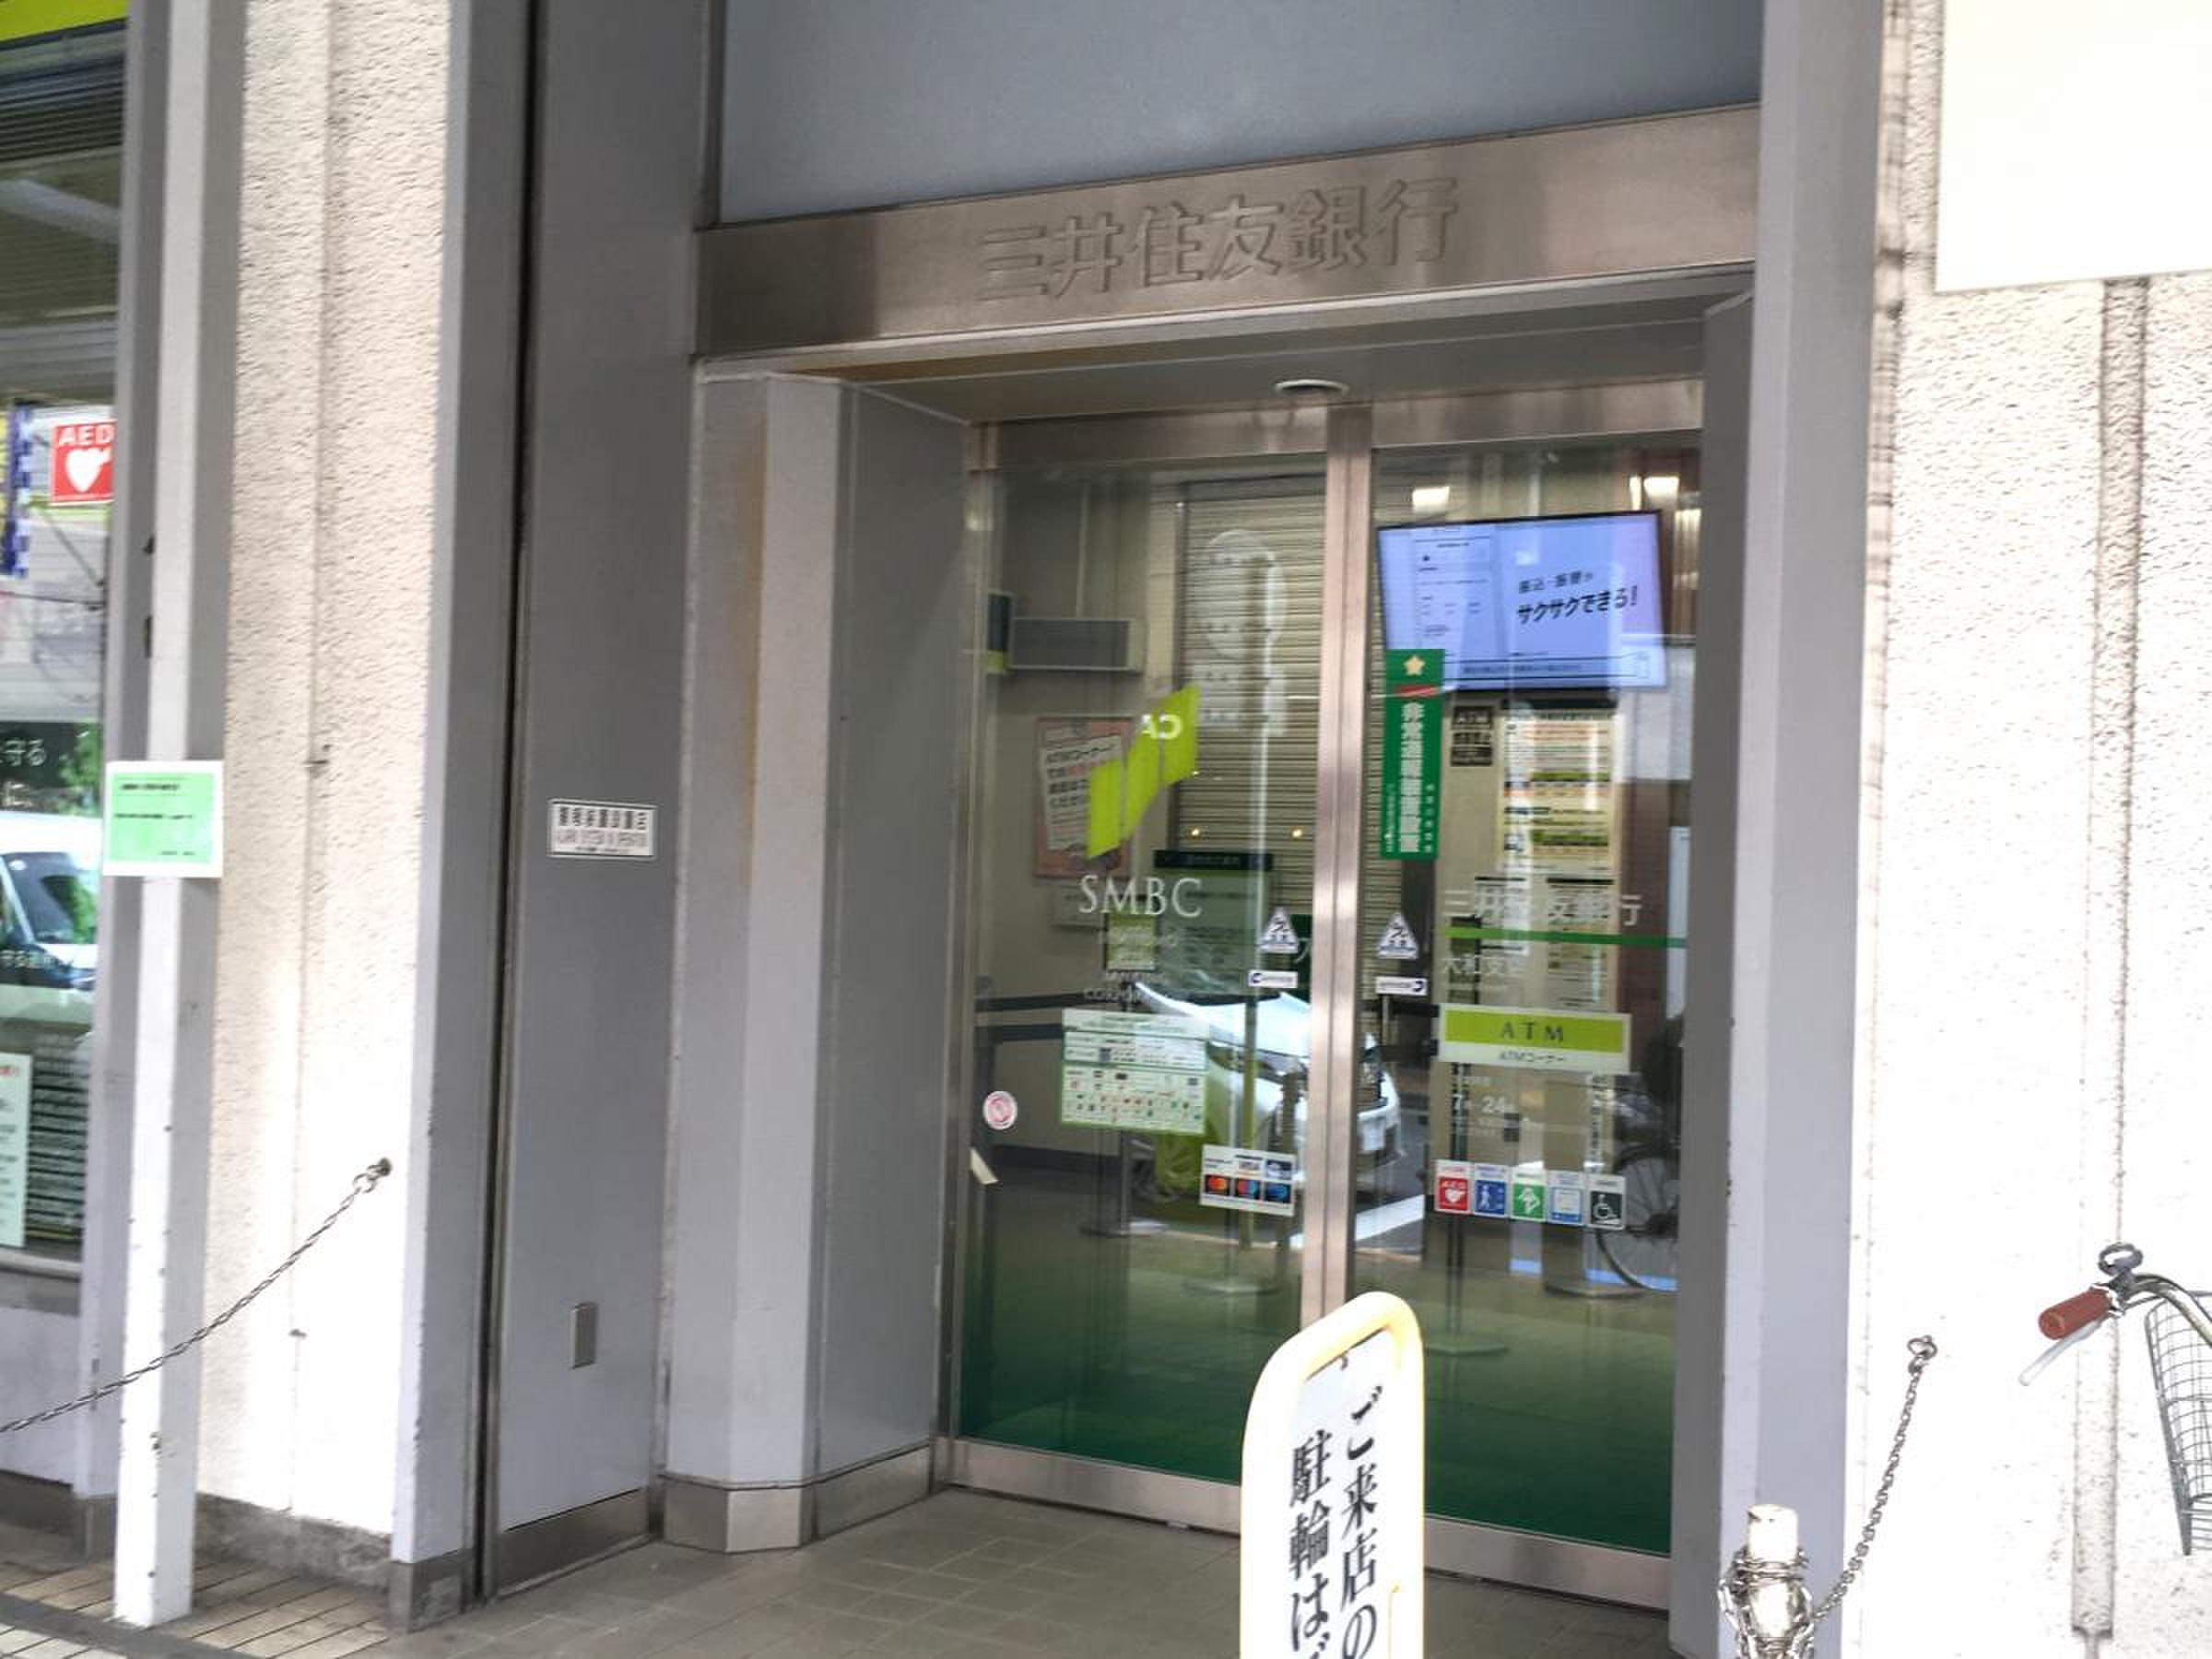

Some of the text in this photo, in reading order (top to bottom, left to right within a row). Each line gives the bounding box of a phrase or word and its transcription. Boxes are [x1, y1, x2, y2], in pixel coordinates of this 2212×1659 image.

[980, 177, 1458, 301] 三井住友銀行
[57, 424, 115, 446] AED
[1077, 874, 1203, 918] SMBC
[1500, 1020, 1565, 1044] ATM
[1288, 1428, 1333, 1659] 駐輪は
[1340, 1383, 1383, 1659] ご来店の
